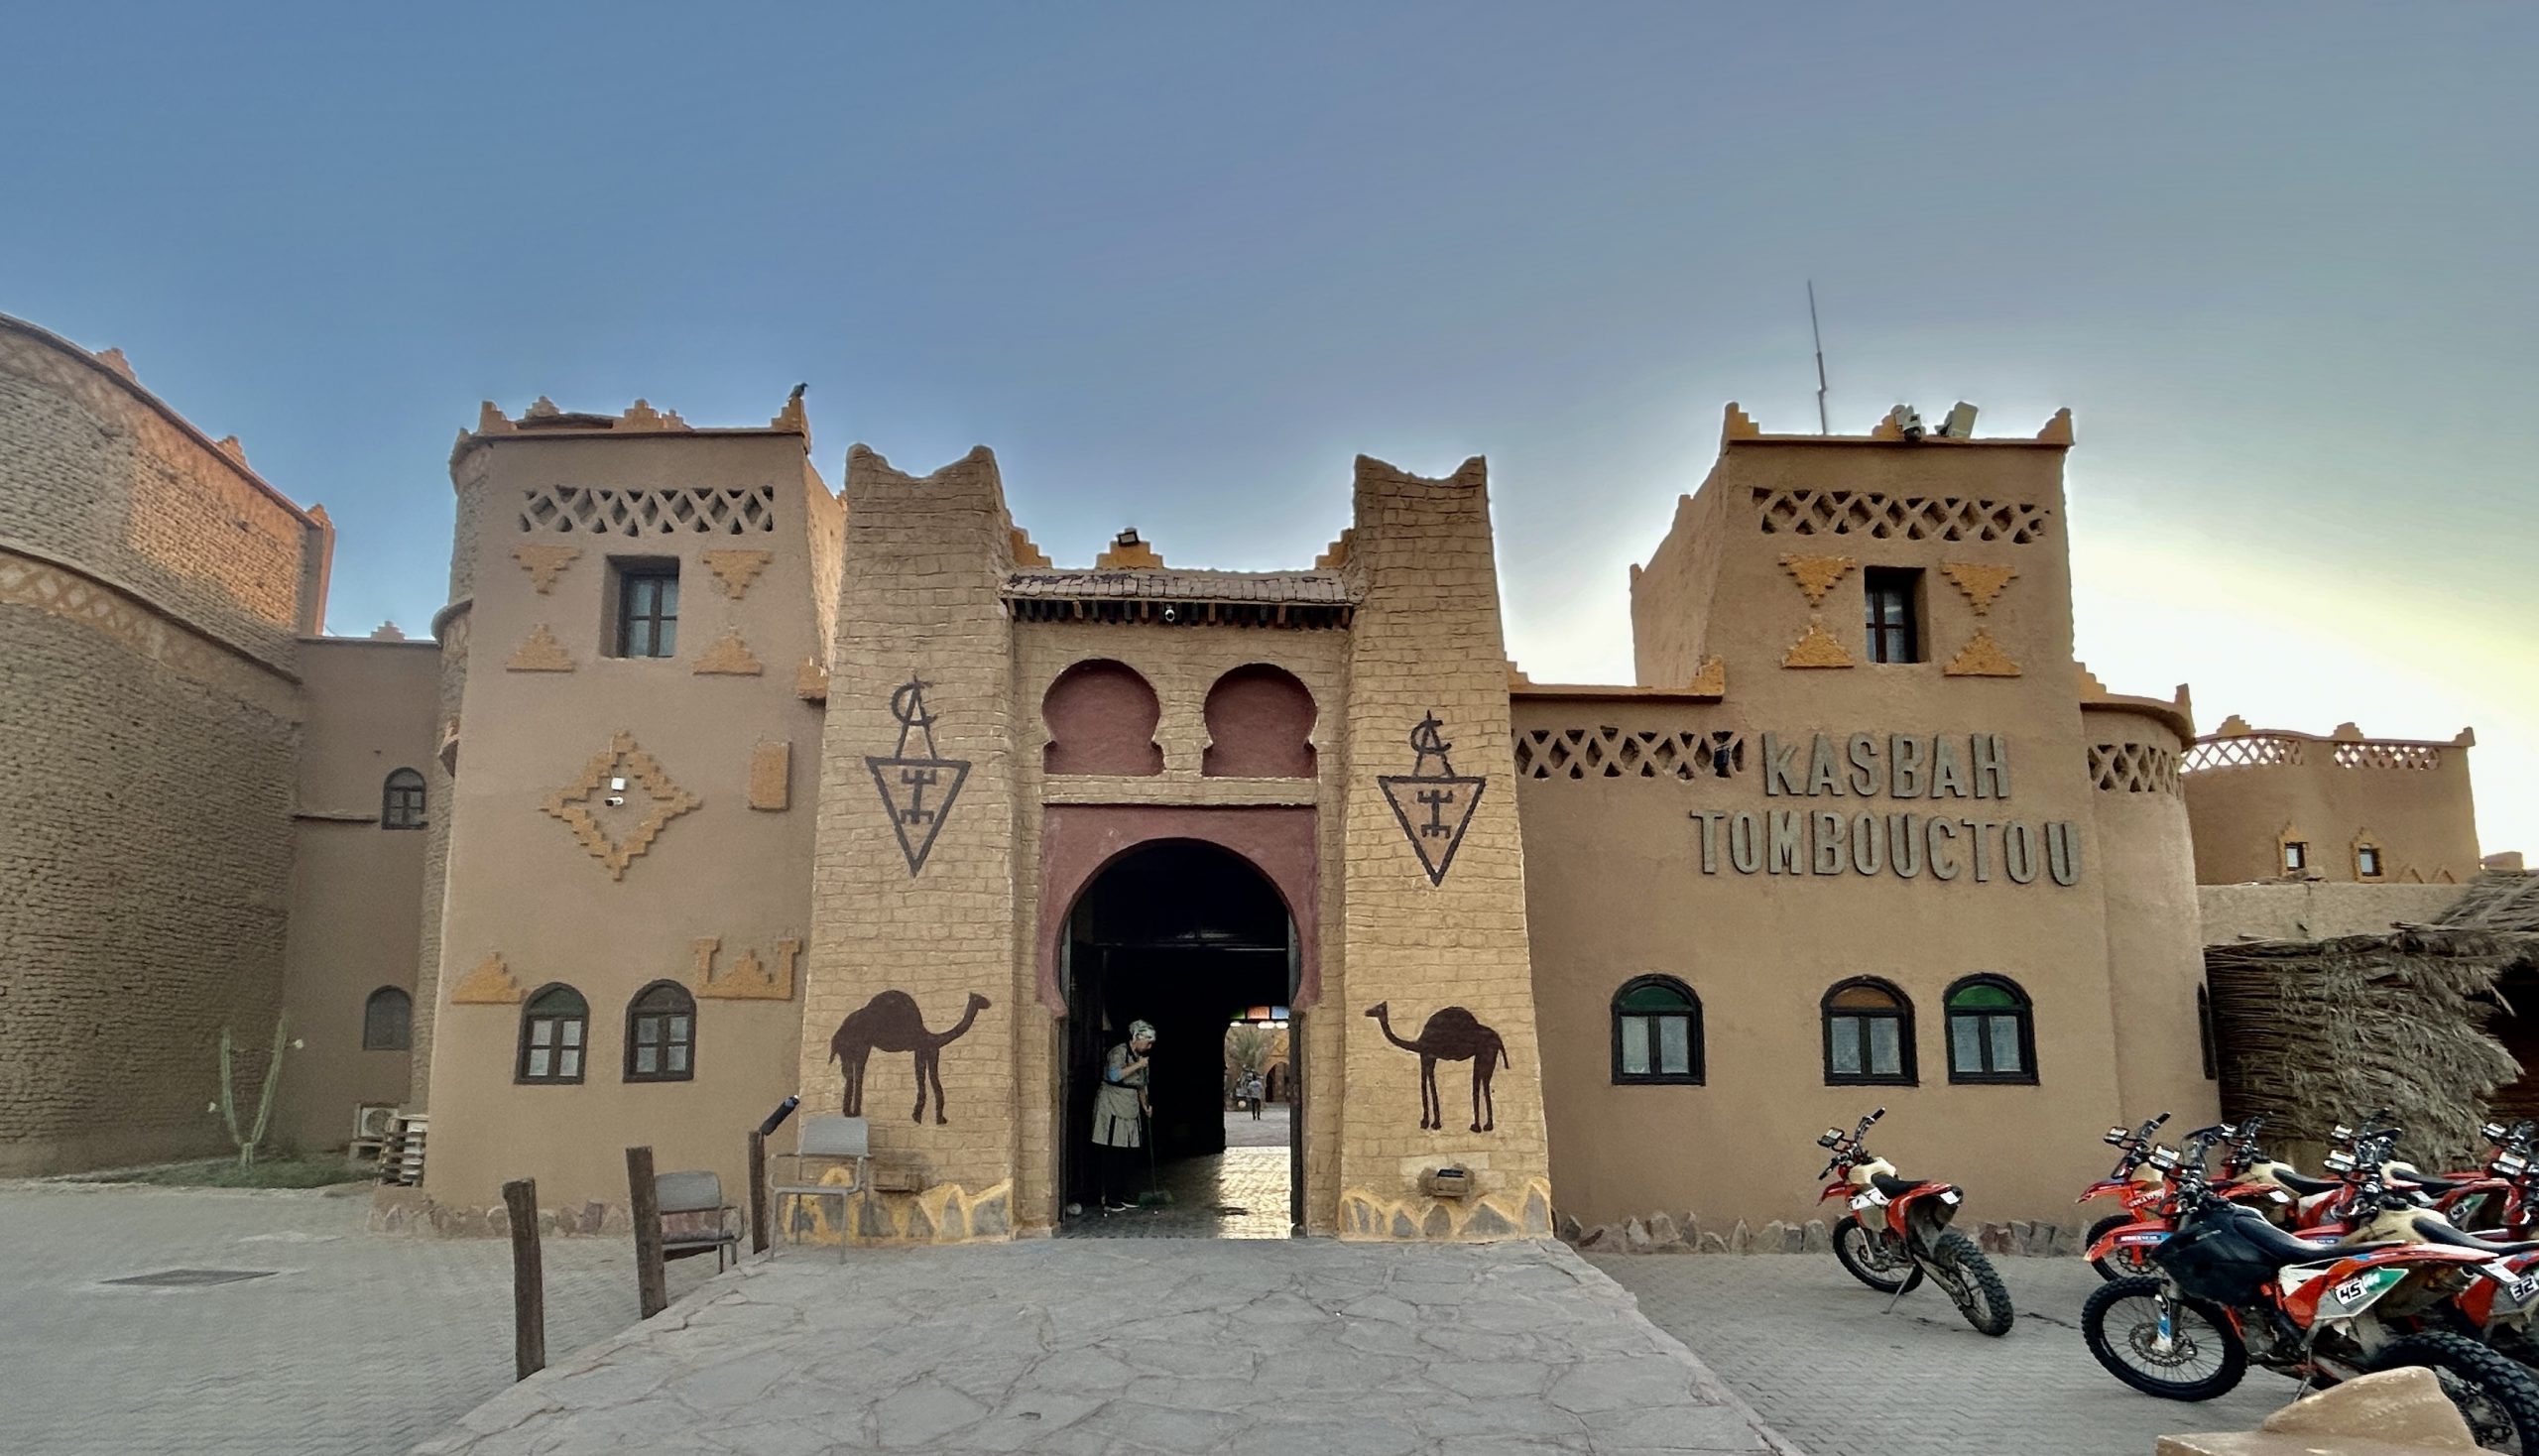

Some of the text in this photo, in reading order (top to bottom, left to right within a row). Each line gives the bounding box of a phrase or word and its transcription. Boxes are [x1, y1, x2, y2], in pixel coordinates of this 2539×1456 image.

[1760, 731, 2010, 798] KASBAH
[1689, 809, 2080, 886] TOMBOUCTOU
[2339, 1281, 2361, 1300] 45
[2512, 1277, 2535, 1299] 32
